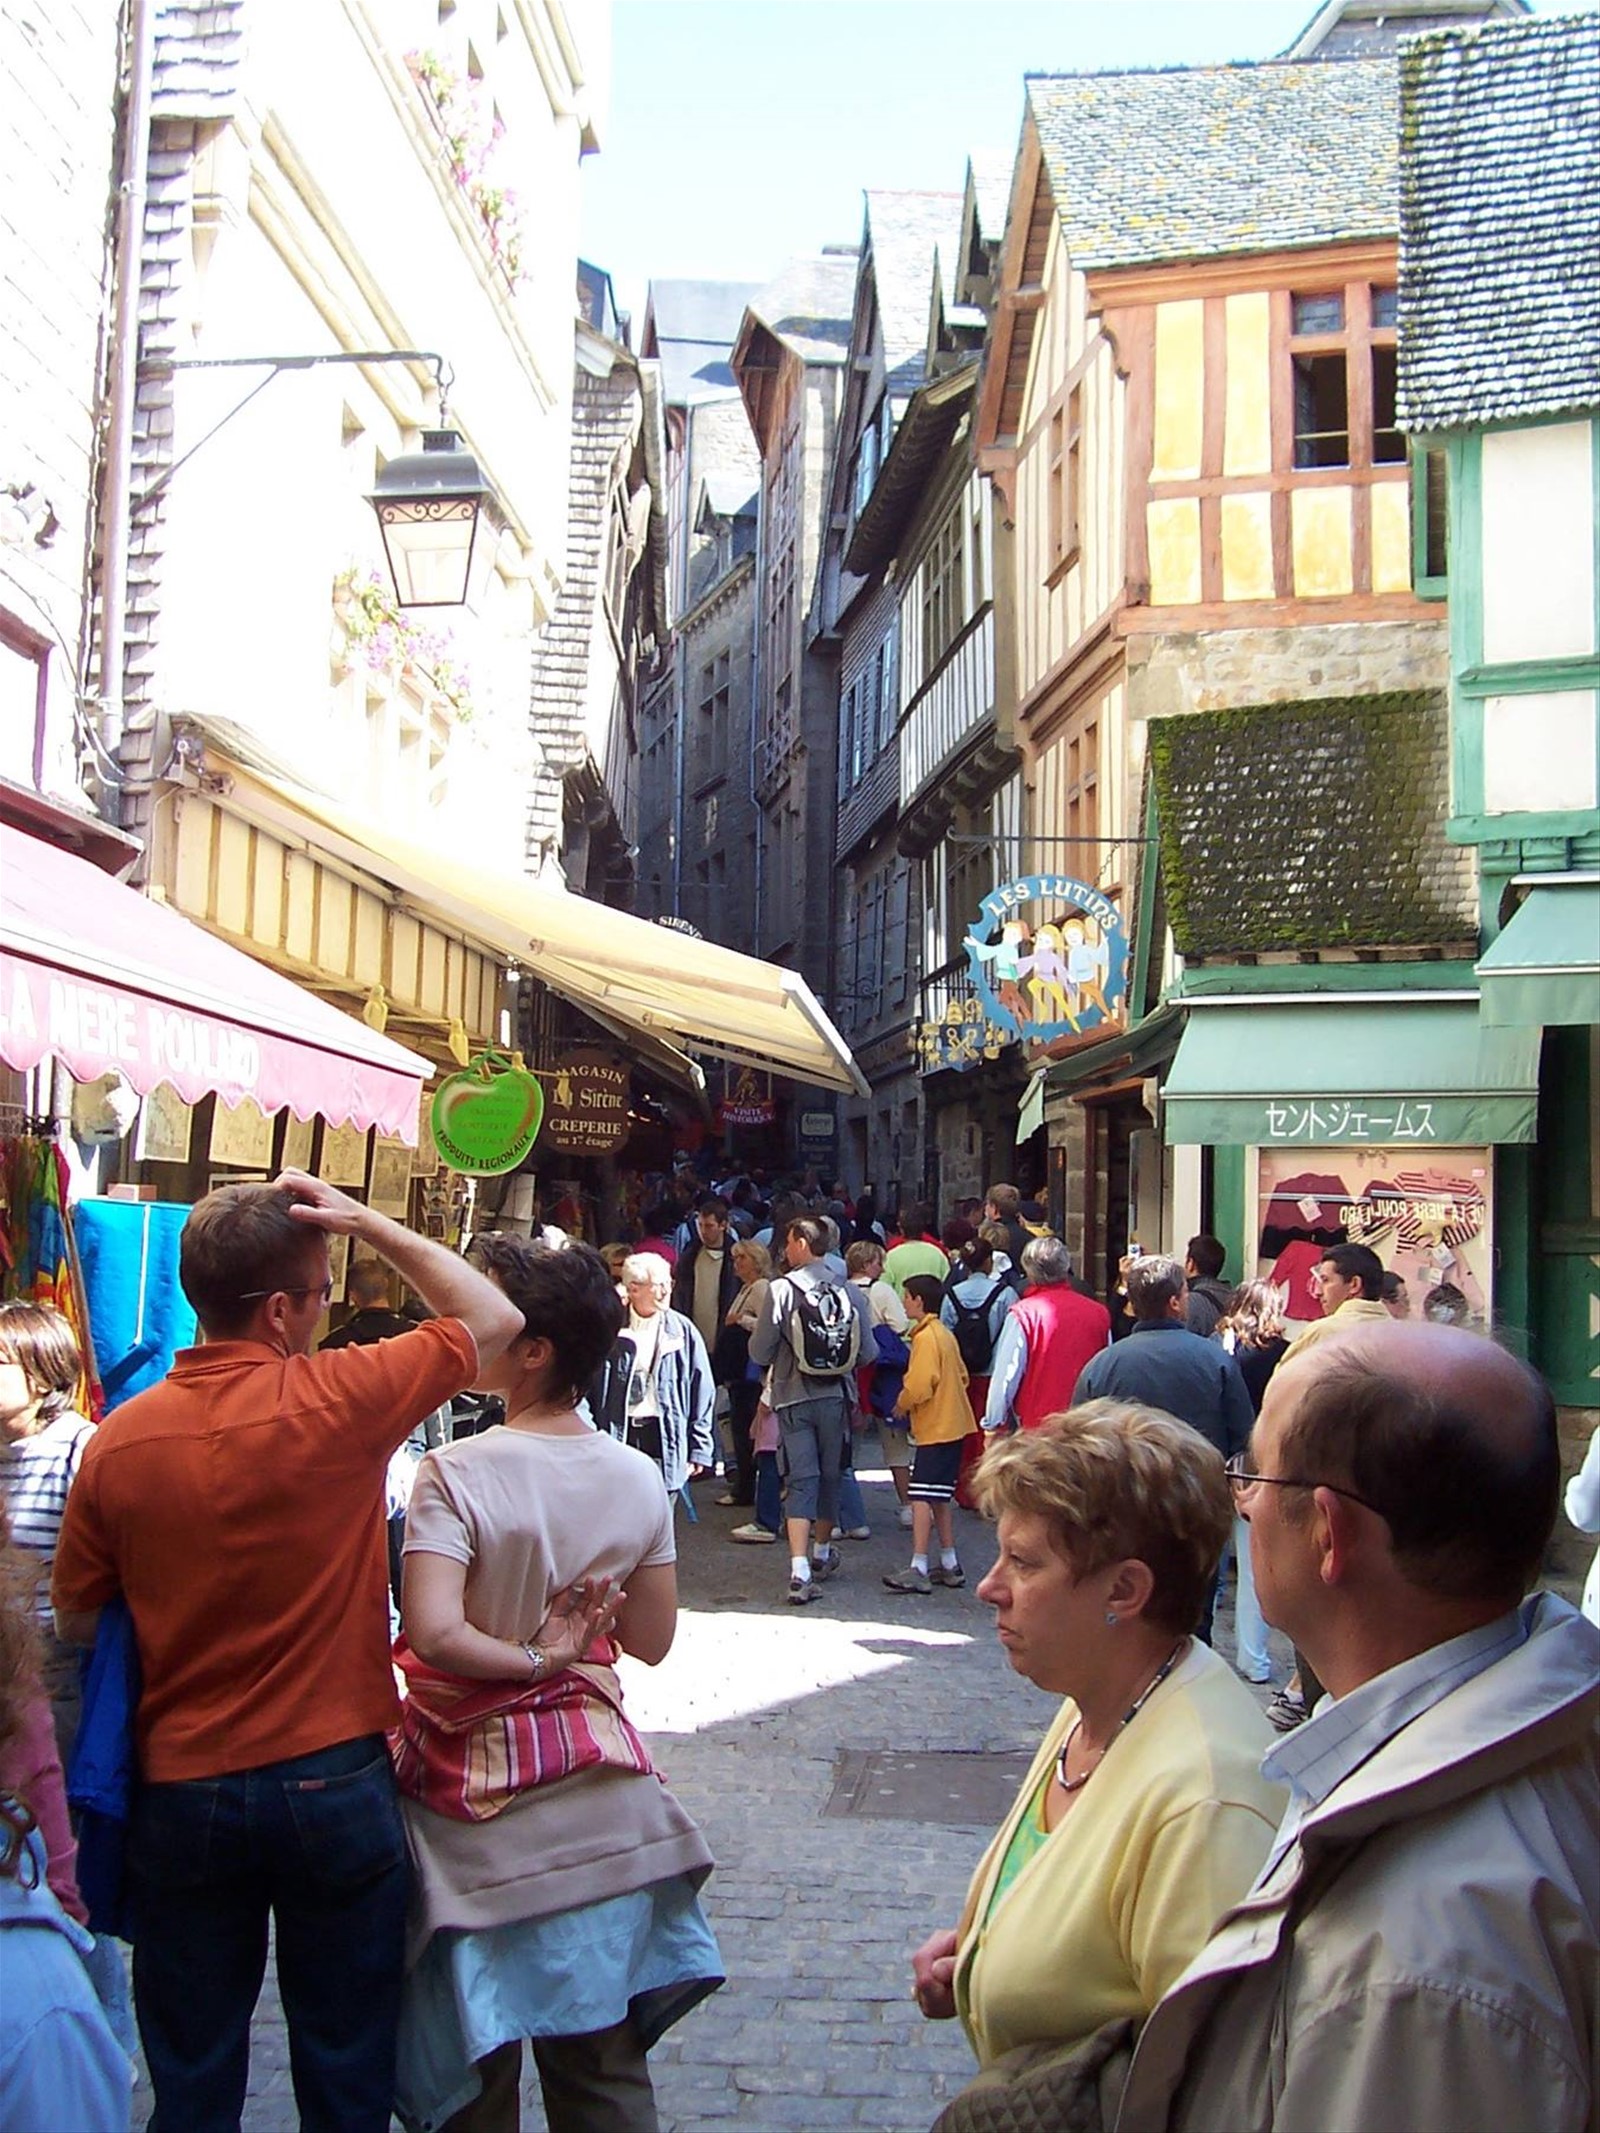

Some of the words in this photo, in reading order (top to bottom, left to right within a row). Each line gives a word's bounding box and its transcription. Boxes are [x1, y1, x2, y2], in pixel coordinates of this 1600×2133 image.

[988, 883, 1031, 917] LES
[1040, 879, 1119, 930] LUTINS
[0, 967, 38, 1041] A
[549, 1118, 622, 1136] CREPERIE
[1265, 1100, 1437, 1139] セントジェームス
[437, 1128, 475, 1168] PRODUITS
[478, 1131, 531, 1170] REGIONAUX
